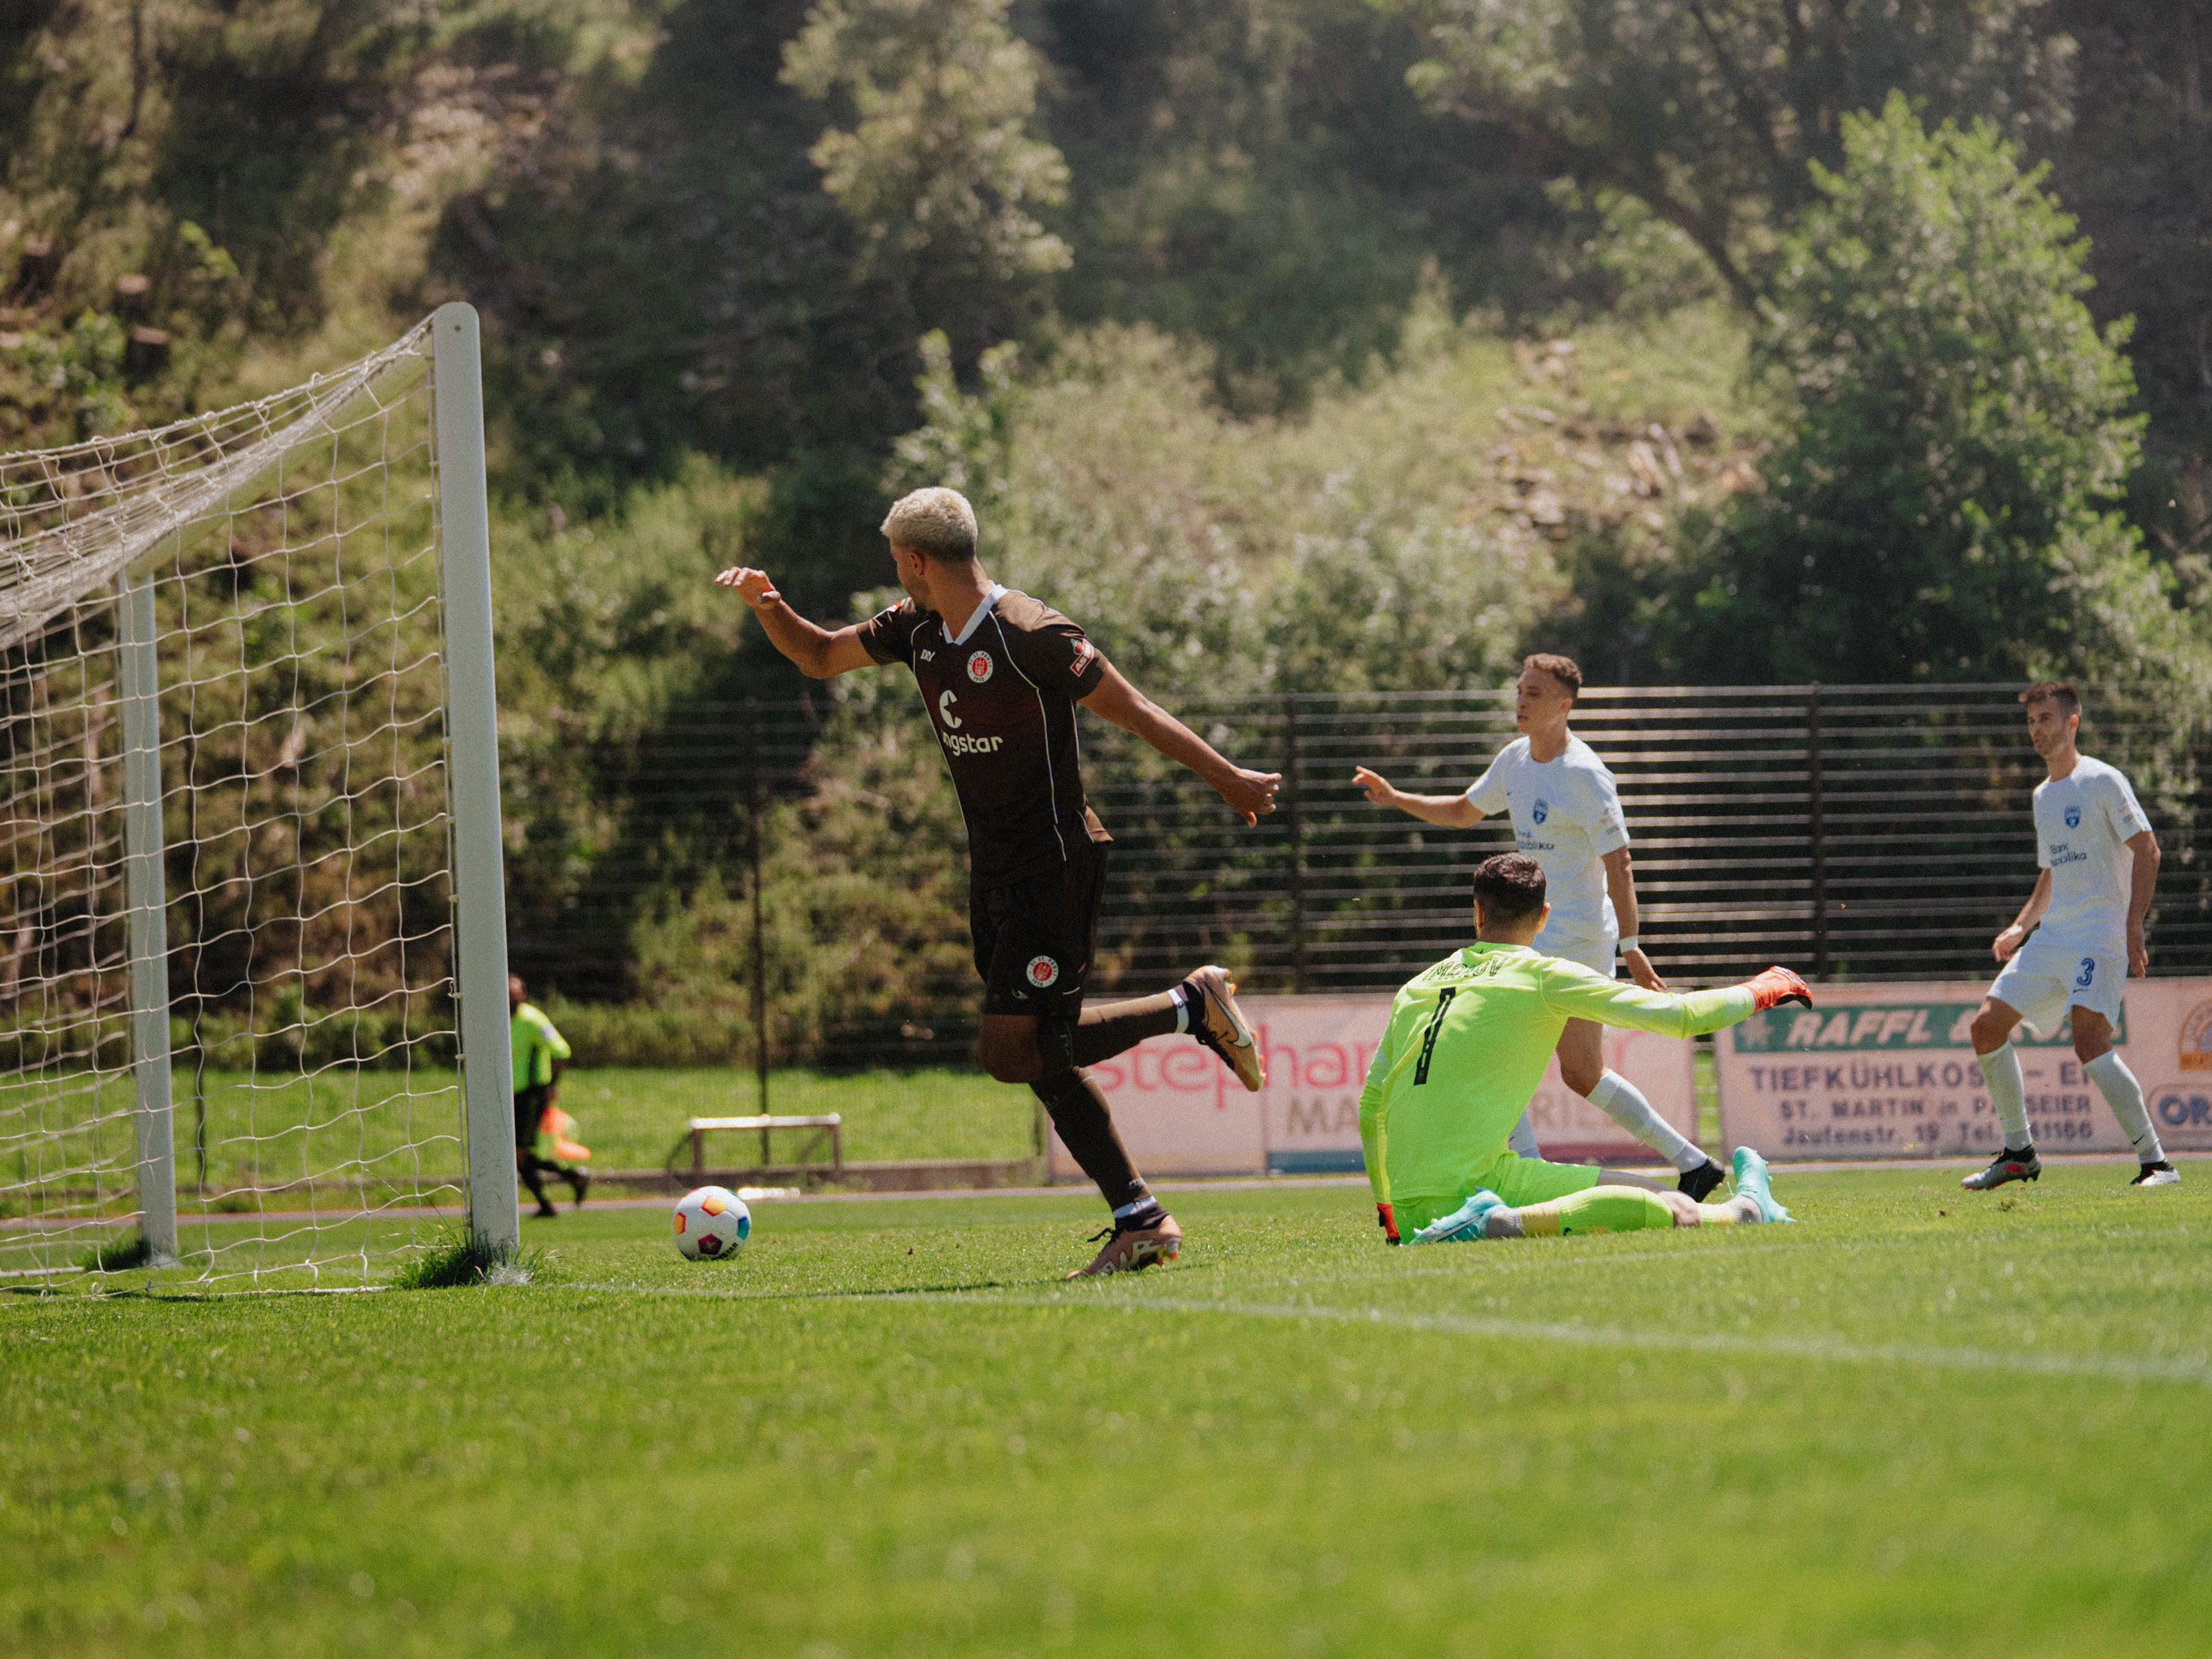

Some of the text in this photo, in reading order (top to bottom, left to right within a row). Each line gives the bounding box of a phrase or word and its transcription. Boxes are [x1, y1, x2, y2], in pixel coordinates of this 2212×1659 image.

[2077, 957, 2095, 986] 3
[1414, 986, 1456, 1085] 1
[1785, 1009, 1932, 1047] RAFFL
[1832, 1097, 1924, 1117] MARTIN
